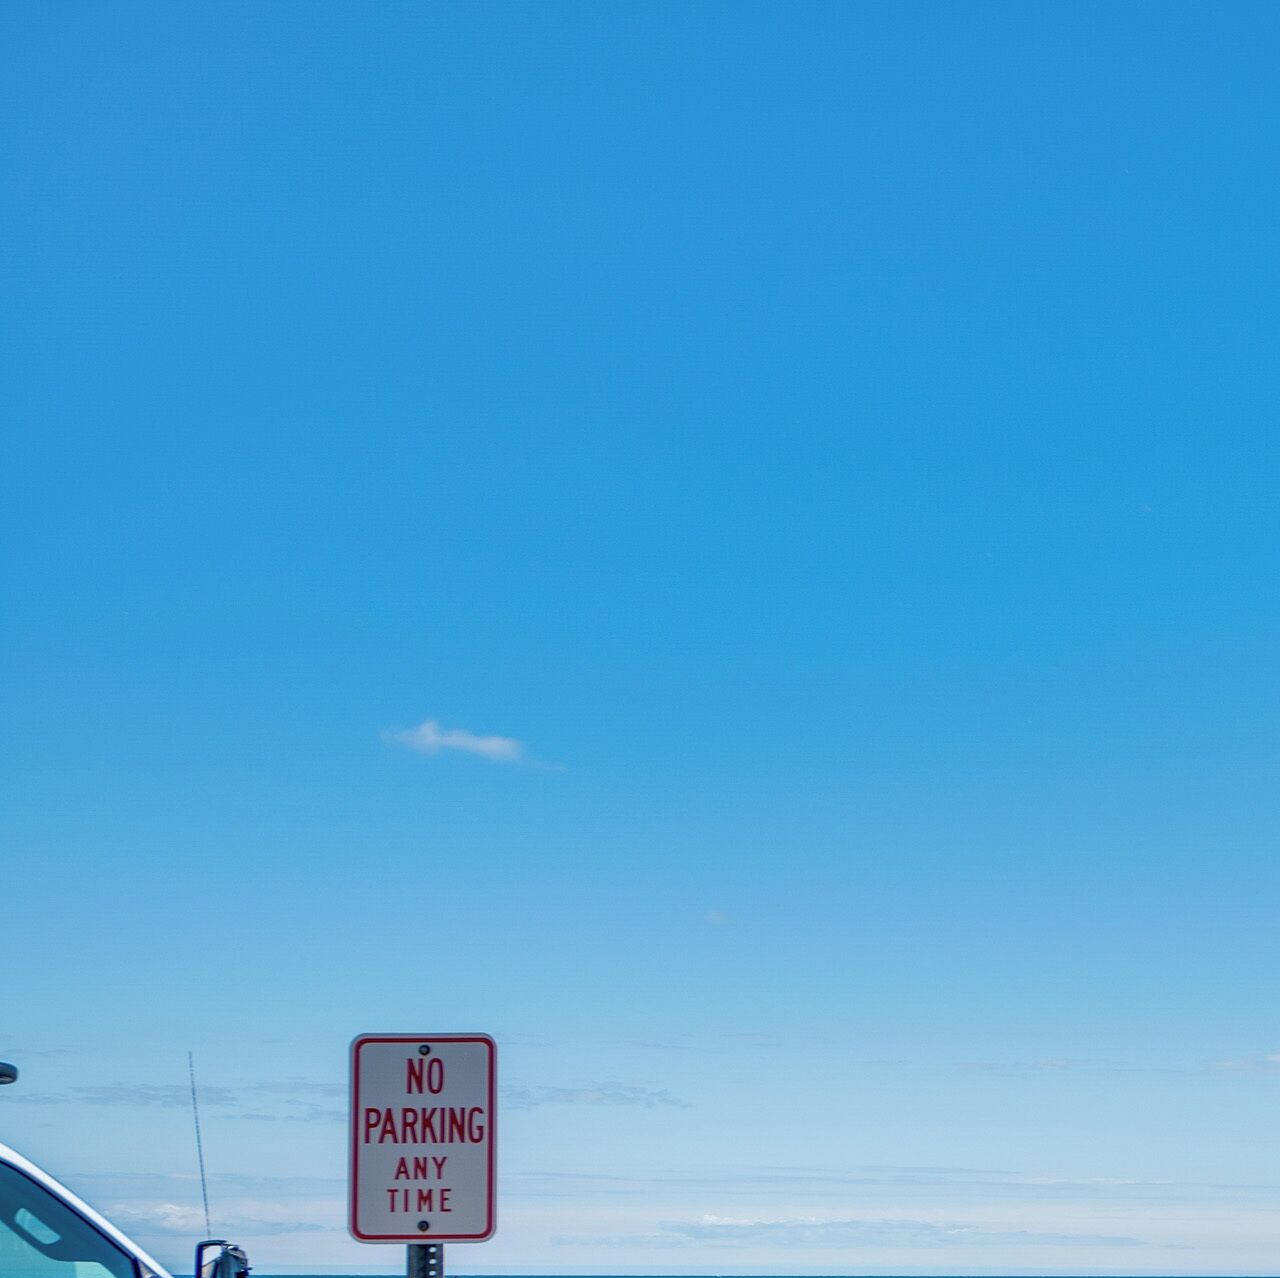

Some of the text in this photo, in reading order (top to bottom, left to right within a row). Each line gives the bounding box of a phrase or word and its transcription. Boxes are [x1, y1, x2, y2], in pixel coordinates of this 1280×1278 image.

[406, 1057, 444, 1094] NO
[364, 1107, 485, 1144] PARKING
[394, 1156, 448, 1180] ANY
[386, 1188, 452, 1212] TIME
